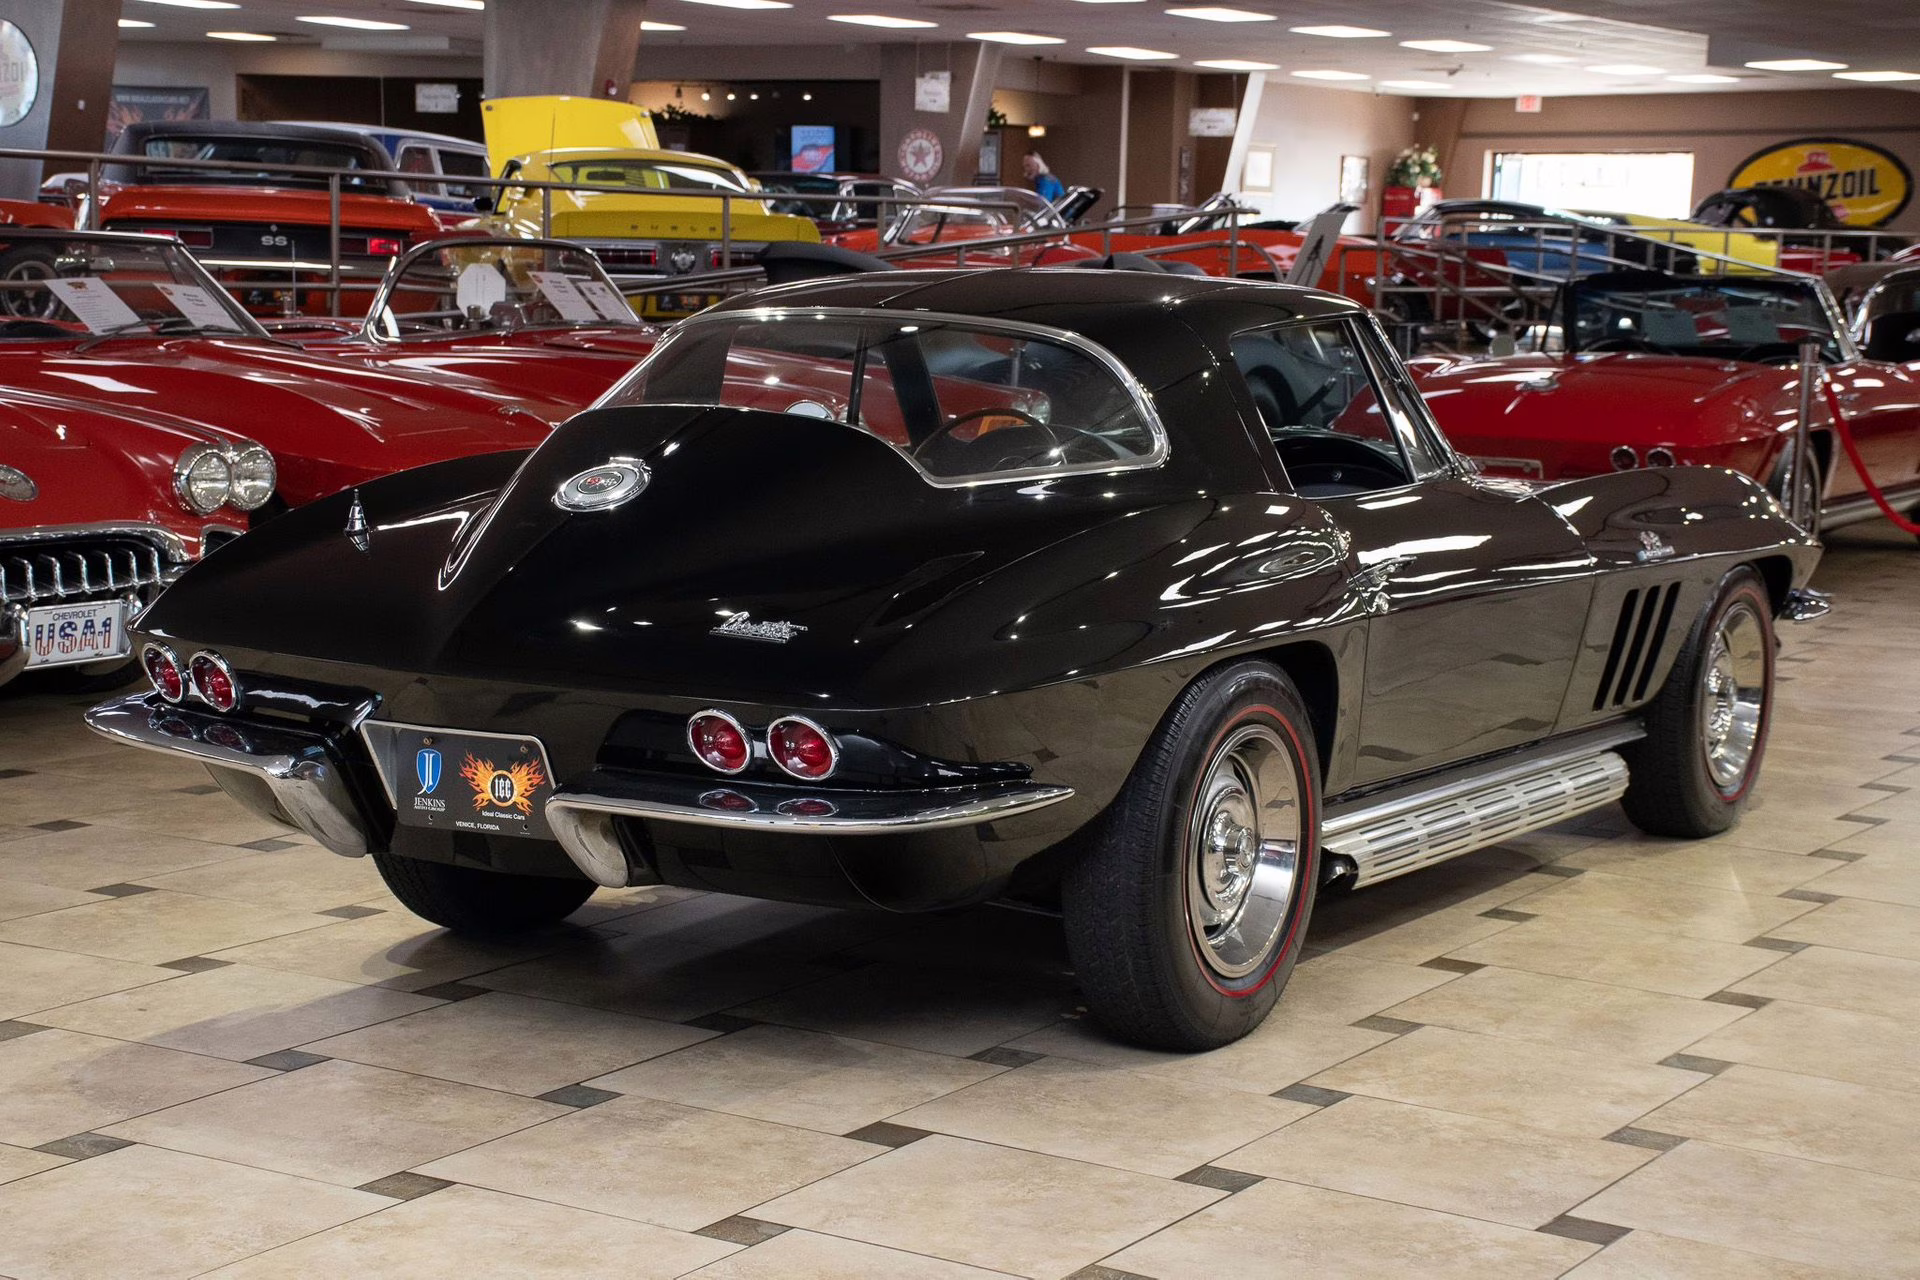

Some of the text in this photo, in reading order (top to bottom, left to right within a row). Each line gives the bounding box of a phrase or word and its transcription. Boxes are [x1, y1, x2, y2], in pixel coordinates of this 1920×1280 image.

[1754, 168, 1881, 200] NZOIL
[261, 235, 288, 246] SS
[53, 609, 97, 621] CHEVROLET
[35, 617, 112, 656] USA-1
[414, 797, 446, 807] JENKINS
[494, 811, 513, 819] Classic
[455, 820, 500, 831] VENICE, FLORIDA
